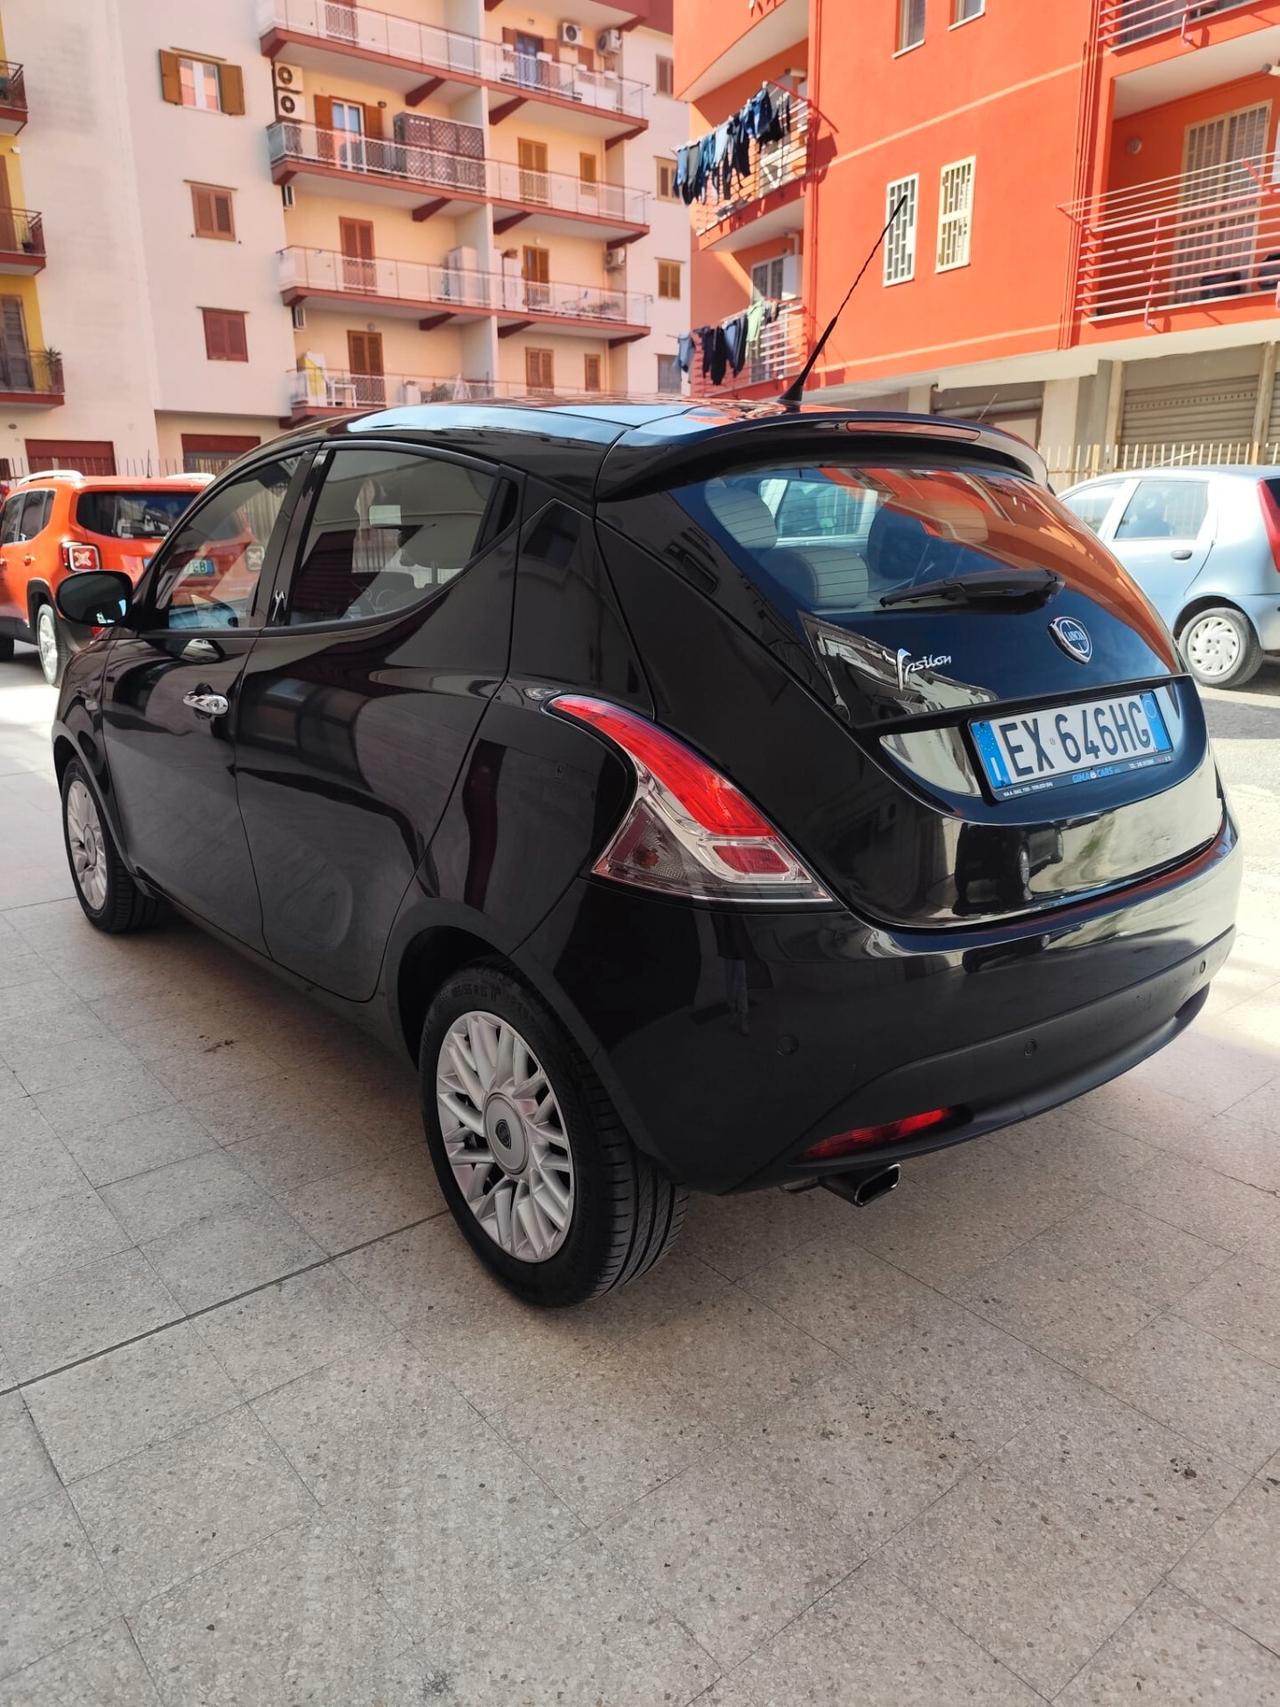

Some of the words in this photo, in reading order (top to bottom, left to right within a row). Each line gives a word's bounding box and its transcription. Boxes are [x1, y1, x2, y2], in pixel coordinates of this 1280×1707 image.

[1064, 630, 1087, 641] LANCIA
[999, 718, 1055, 777] EX
[1055, 701, 1151, 763] 646HG
